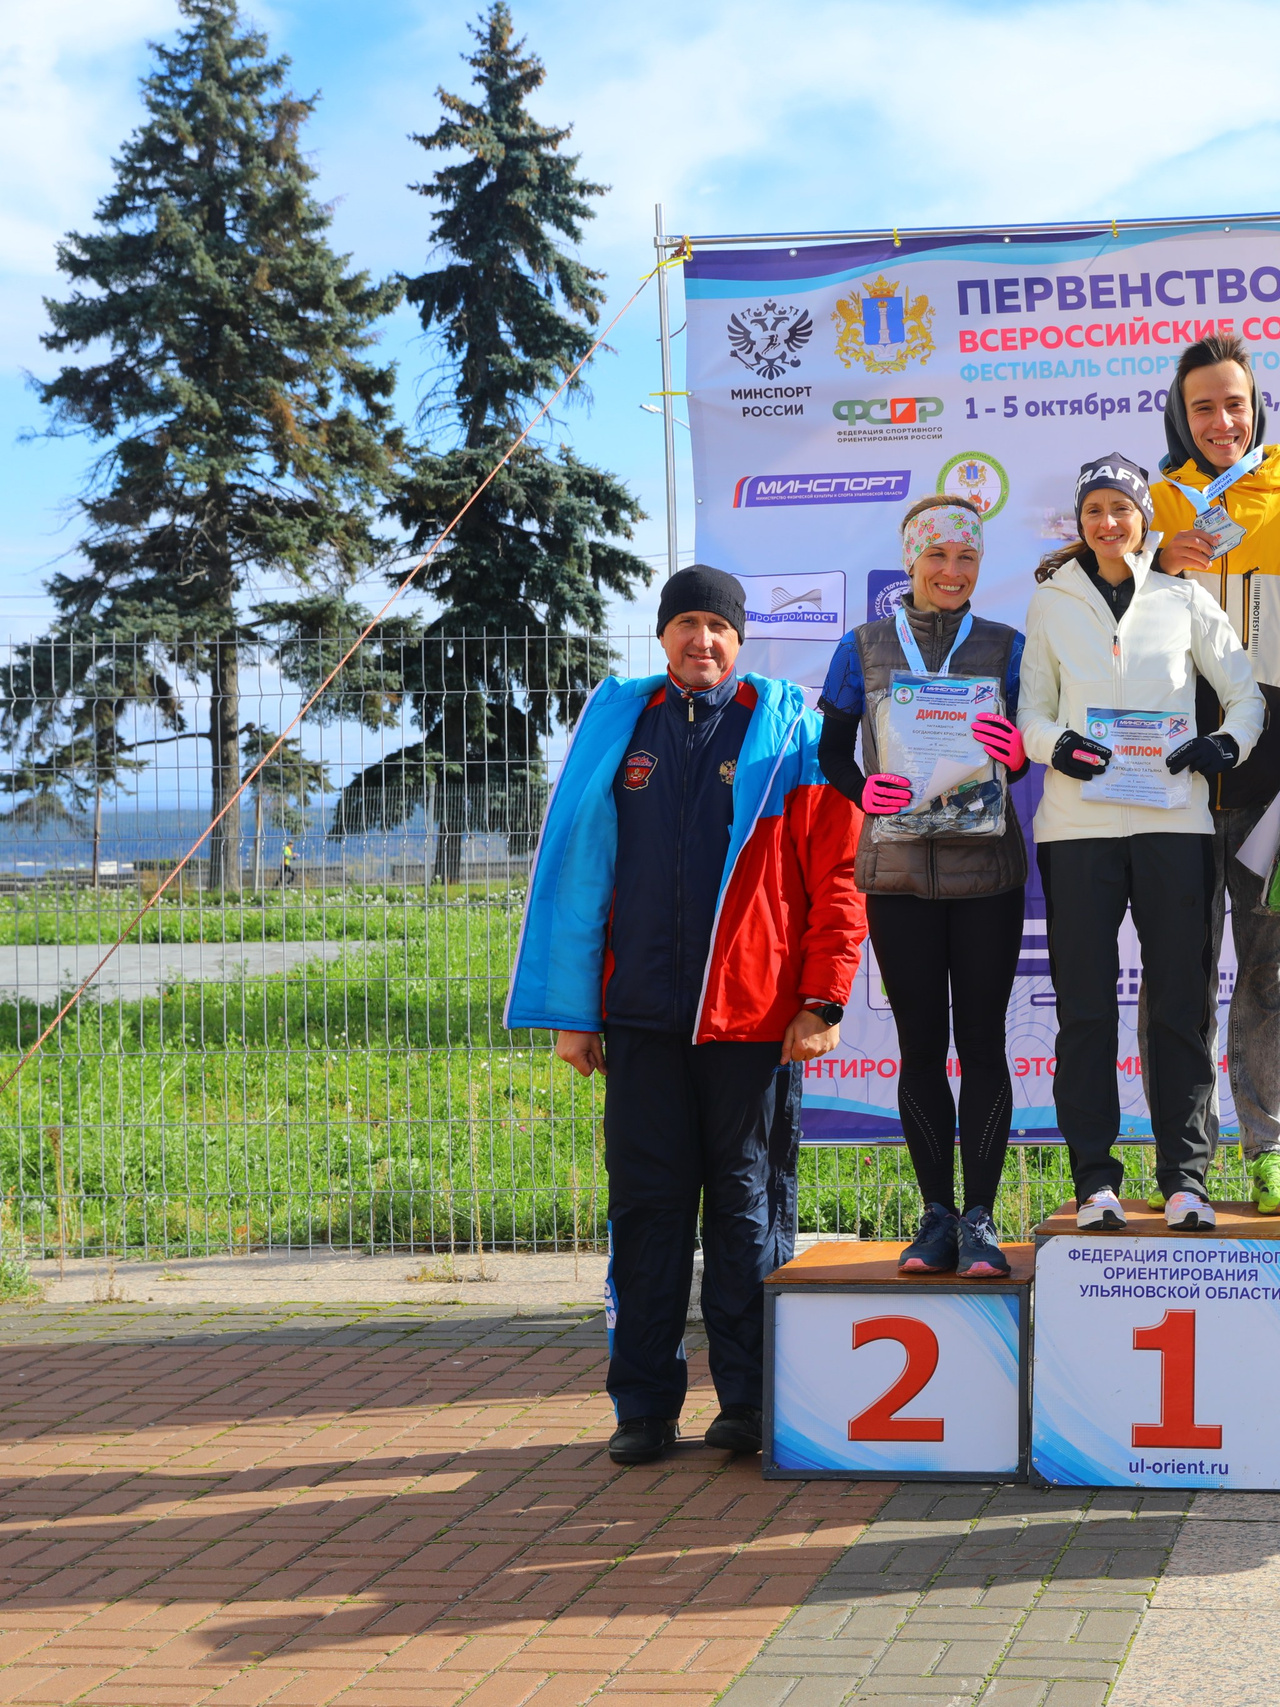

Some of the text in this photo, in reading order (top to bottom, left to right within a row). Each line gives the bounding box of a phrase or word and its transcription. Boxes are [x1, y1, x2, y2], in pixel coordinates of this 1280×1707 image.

[959, 316, 1234, 353] ВСЕРОССИЙСКИЕ
[960, 359, 1101, 383] ФЕСТИВАЛЬ
[1106, 351, 1280, 377] СПОРТГО
[731, 386, 812, 400] МИНСПОРТ
[742, 404, 804, 418] РОССИИ
[965, 397, 978, 419] 1
[1003, 396, 1018, 418] 5
[1025, 392, 1130, 421] октября
[837, 426, 943, 437] ФЕДЕРАЦИЯ СПОРТИВНОГО
[837, 435, 908, 443] ОРИЕНТИРОВАНИЯ
[756, 476, 904, 495] МИНСПОРТ
[883, 580, 911, 593] ГЕОГРАФ
[915, 708, 967, 722] ДИПЛОМ
[1082, 740, 1110, 754] VICTORY
[1112, 744, 1162, 757] ДИПЛОМ
[1167, 740, 1193, 760] VICTORY
[1068, 1248, 1167, 1264] ФЕДЕРАЦИЯ
[1103, 1267, 1259, 1282] ОРИЕНТИРОВАНИЯ
[1079, 1283, 1200, 1299] УЛЬЯНОВСКОЙ
[847, 1314, 945, 1443] 2
[1131, 1309, 1223, 1450] 1
[1128, 1457, 1229, 1478] ul-orient.ru
